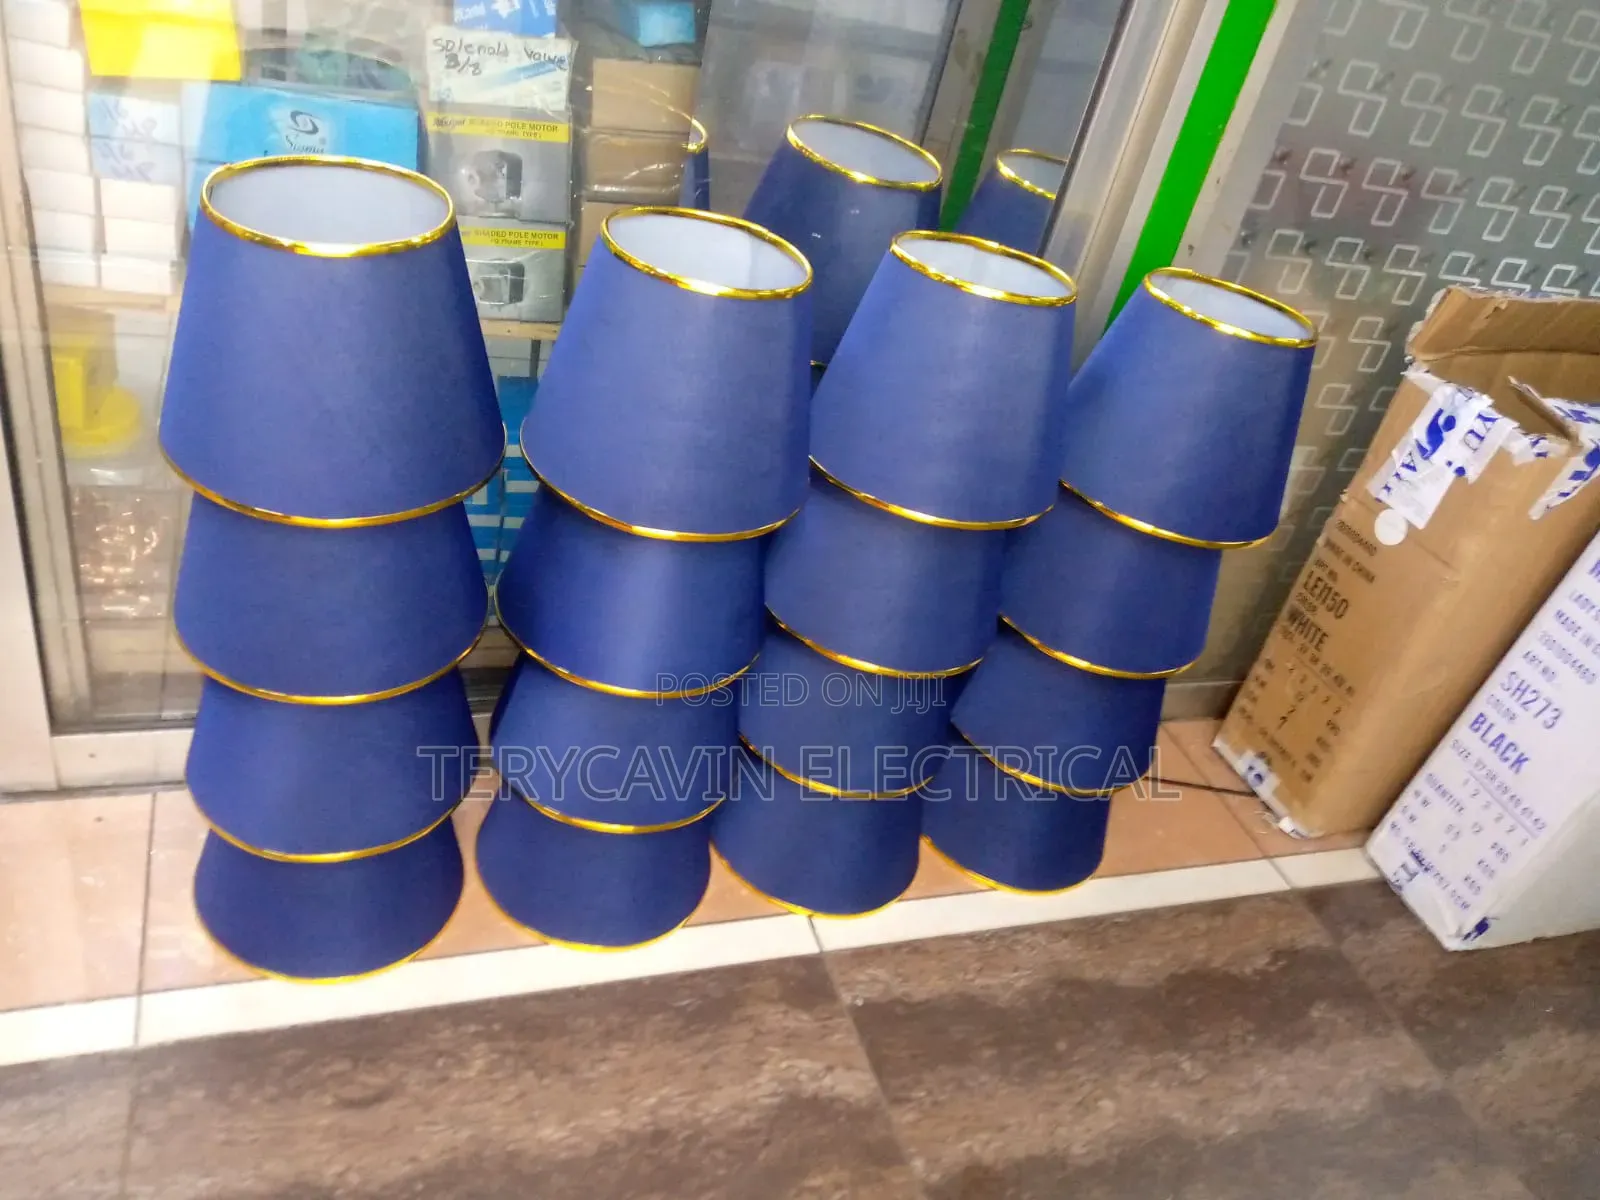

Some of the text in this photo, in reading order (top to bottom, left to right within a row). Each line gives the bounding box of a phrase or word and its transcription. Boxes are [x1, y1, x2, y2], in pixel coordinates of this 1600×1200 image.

[505, 121, 527, 131] POLE
[529, 123, 559, 133] MOTOR
[508, 231, 529, 239] POLE
[531, 232, 559, 241] MOTOR
[1286, 612, 1330, 652] WHITE
[1500, 671, 1562, 730] SH273
[1468, 711, 1531, 775] BLACK
